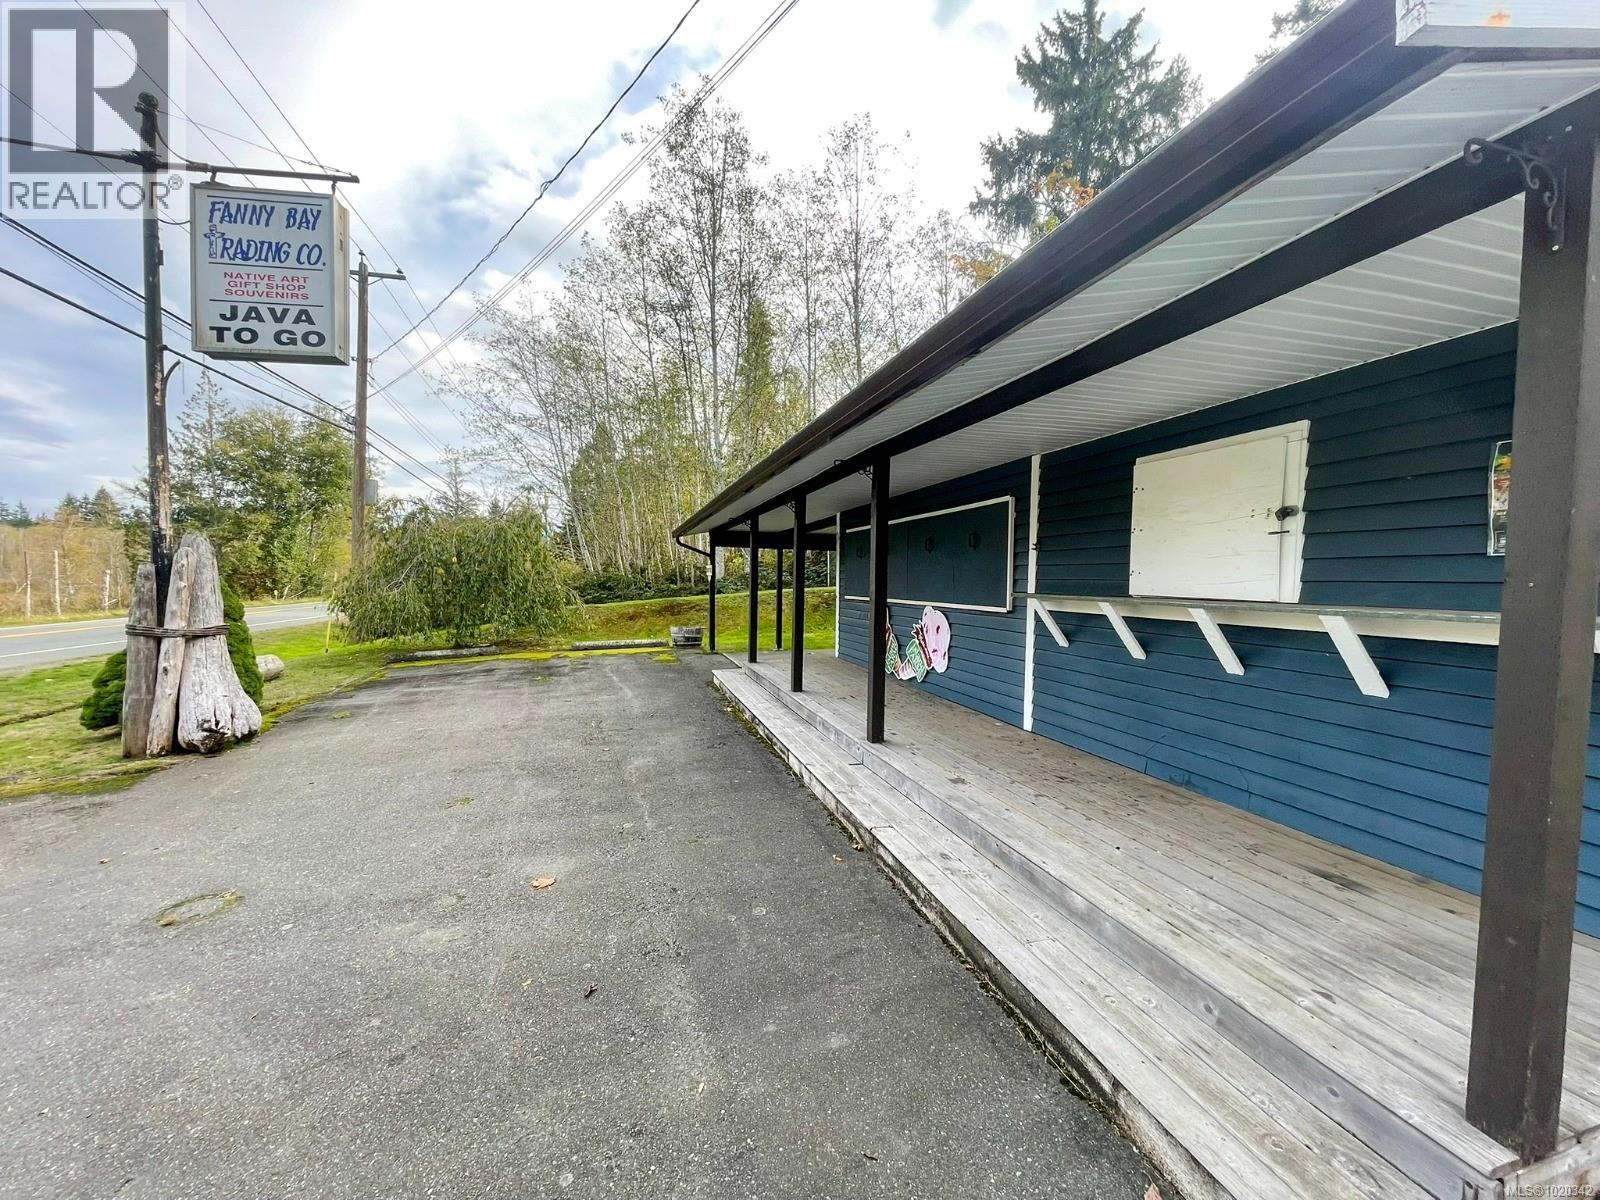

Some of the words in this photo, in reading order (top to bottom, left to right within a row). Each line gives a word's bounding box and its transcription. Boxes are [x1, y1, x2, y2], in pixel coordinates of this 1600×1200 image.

[208, 201, 275, 228] FANNY
[285, 207, 322, 231] BAY
[296, 243, 326, 267] CO.
[223, 271, 275, 282] NATIVE
[281, 275, 309, 284] ART
[227, 280, 260, 289] GIFT
[265, 282, 306, 292] SHOP
[224, 288, 310, 301] SOUVENIRS
[219, 305, 316, 326] JAVA
[209, 326, 259, 345] TO
[273, 329, 326, 348] GO
